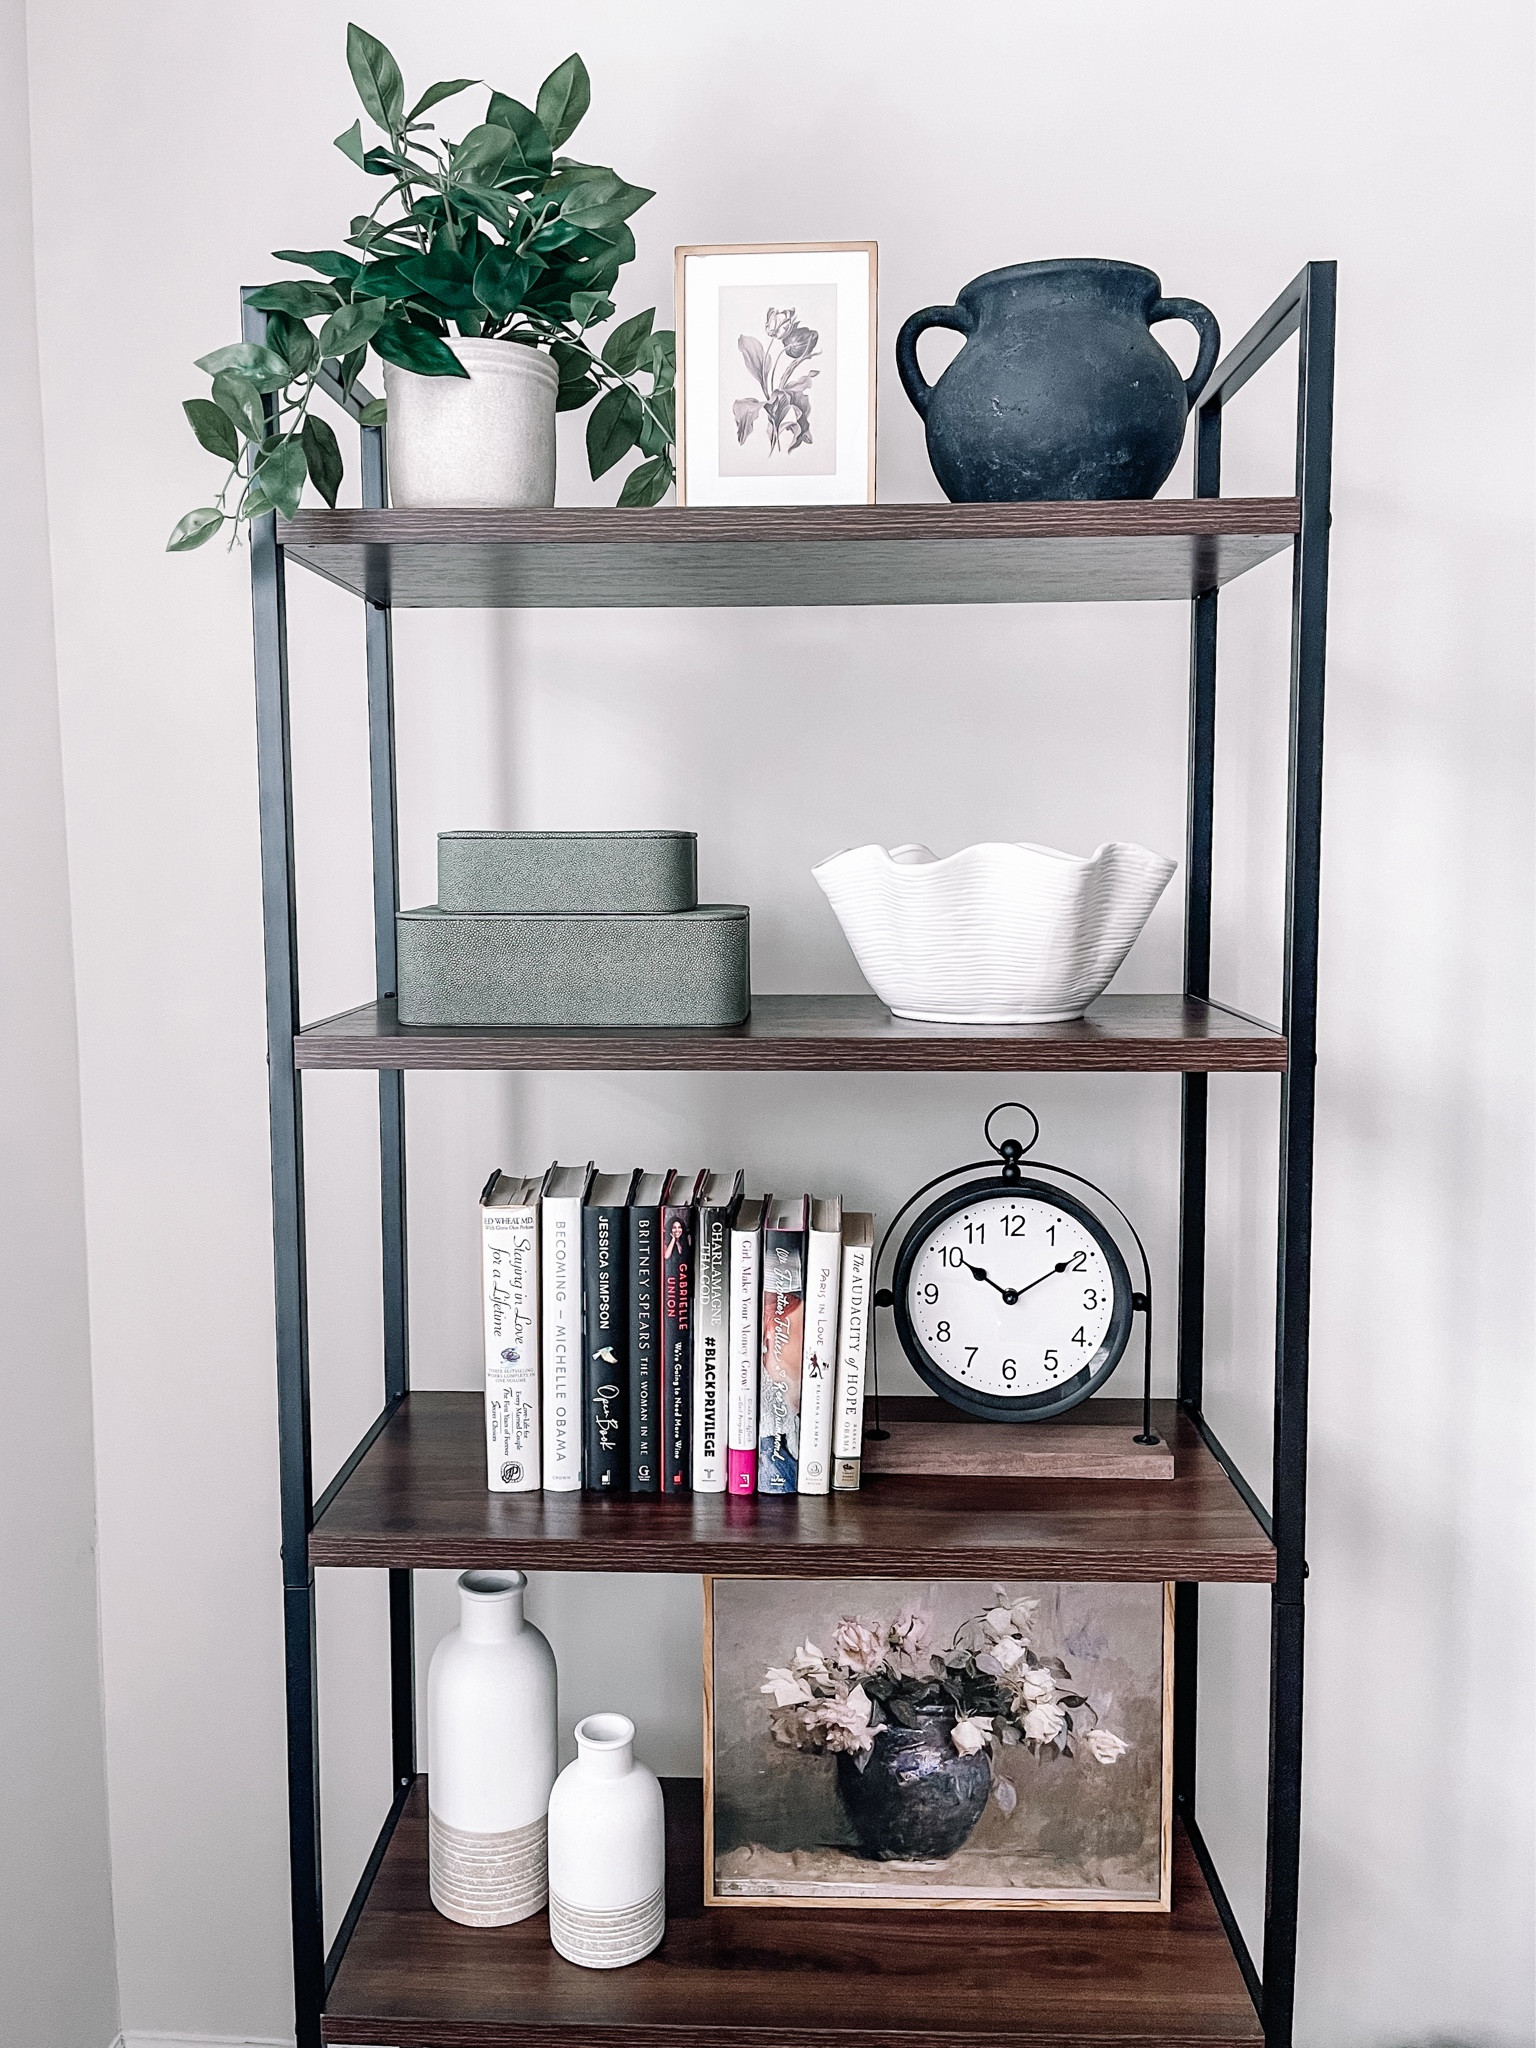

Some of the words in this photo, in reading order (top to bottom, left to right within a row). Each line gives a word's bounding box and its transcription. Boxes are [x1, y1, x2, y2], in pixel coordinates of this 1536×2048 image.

[963, 1222, 986, 1245] 11
[1000, 1214, 1026, 1237] 12
[1045, 1225, 1056, 1247] 1
[598, 1215, 609, 1268] JESSICA
[740, 1240, 751, 1262] Girl,
[488, 1243, 511, 1265] for
[509, 1235, 532, 1289] Staying
[555, 1221, 566, 1302] BECOMING
[638, 1219, 650, 1288] BRITNEY
[700, 1242, 710, 1269] THA
[852, 1253, 864, 1274] The
[937, 1246, 964, 1268] 10
[1072, 1250, 1087, 1273] 2
[492, 1269, 502, 1278] a
[711, 1222, 722, 1326] CHARLAMAGNE
[741, 1265, 751, 1294] Make
[816, 1268, 830, 1298] PARIS
[514, 1292, 528, 1305] in
[599, 1271, 610, 1330] SIMPSON
[666, 1277, 676, 1318] UNION
[679, 1263, 688, 1331] GABRIELLE
[700, 1273, 710, 1306] GOD
[774, 1267, 793, 1316] Frontier
[924, 1283, 939, 1305] 9
[1083, 1288, 1098, 1310] 3
[489, 1280, 512, 1337] Lifetime
[741, 1297, 751, 1321] Your
[818, 1303, 826, 1314] IN
[849, 1275, 863, 1352] AUDACITY
[512, 1307, 532, 1344] Love
[638, 1293, 650, 1350] SPEARS
[815, 1318, 828, 1346] LOVE
[936, 1321, 951, 1342] 8
[738, 1323, 751, 1357] Money
[773, 1316, 791, 1362] Follies
[1071, 1326, 1087, 1347] 4
[555, 1325, 566, 1399] MICHELLE
[673, 1341, 682, 1362] We're
[964, 1346, 979, 1368] 7
[1043, 1349, 1059, 1371] 5
[639, 1357, 649, 1377] THE
[672, 1363, 682, 1386] Going
[844, 1357, 859, 1370] of
[1002, 1358, 1017, 1380] 6
[740, 1360, 751, 1391] Grow!
[503, 1387, 513, 1400] The
[514, 1391, 522, 1406] Every
[592, 1384, 620, 1419] Open
[639, 1380, 649, 1421] WOMAN
[673, 1387, 682, 1396] to
[704, 1336, 716, 1458] #BLACKPRIVILEGE
[771, 1382, 789, 1402] Ree
[845, 1373, 859, 1416] HOPE
[490, 1400, 502, 1419] Secret
[515, 1407, 523, 1430] Married
[673, 1397, 682, 1417] Need
[556, 1406, 567, 1462] OBAMA
[595, 1414, 619, 1451] Book
[640, 1426, 649, 1437] IN
[673, 1418, 682, 1439] More
[771, 1403, 788, 1462] Drummond
[842, 1421, 851, 1452] OBAMA
[514, 1430, 523, 1451] Couple
[640, 1441, 649, 1455] ME
[673, 1439, 682, 1459] Wine
